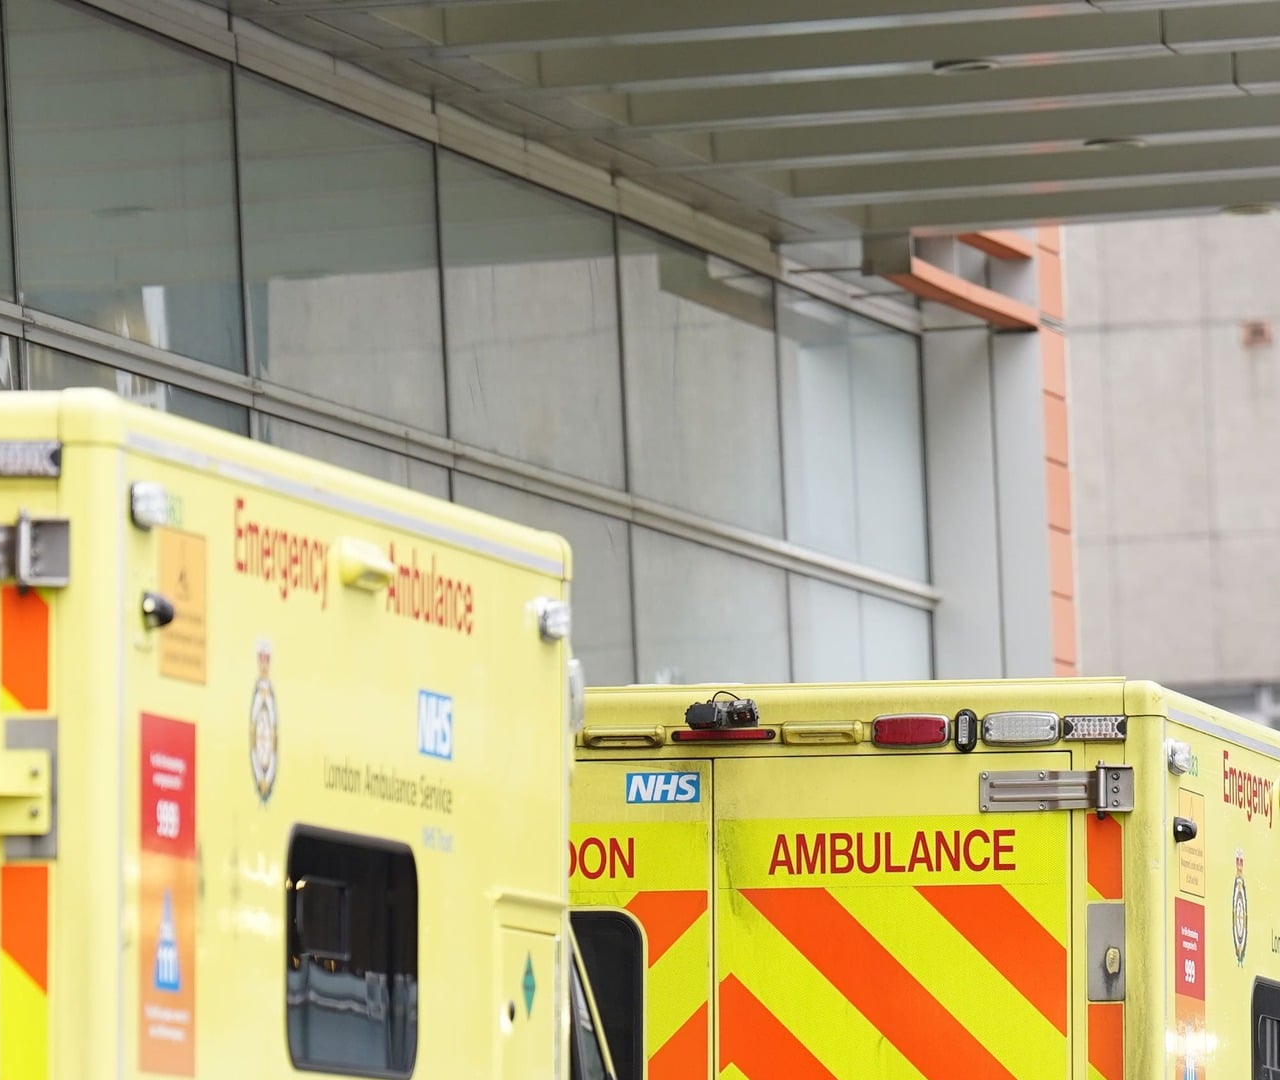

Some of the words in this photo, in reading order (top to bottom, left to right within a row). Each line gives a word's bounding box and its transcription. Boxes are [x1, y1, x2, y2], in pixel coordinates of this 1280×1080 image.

[234, 497, 329, 611] Emergency
[386, 541, 474, 636] Ambulance
[419, 692, 451, 757] NHS
[323, 755, 361, 793] London
[363, 761, 417, 808] Ambulance
[419, 774, 453, 814] Service
[626, 772, 700, 804] NHS
[1223, 750, 1273, 829] Emergency
[568, 836, 635, 880] ON
[768, 828, 1016, 876] AMBULANCE
[1184, 958, 1196, 984] 999
